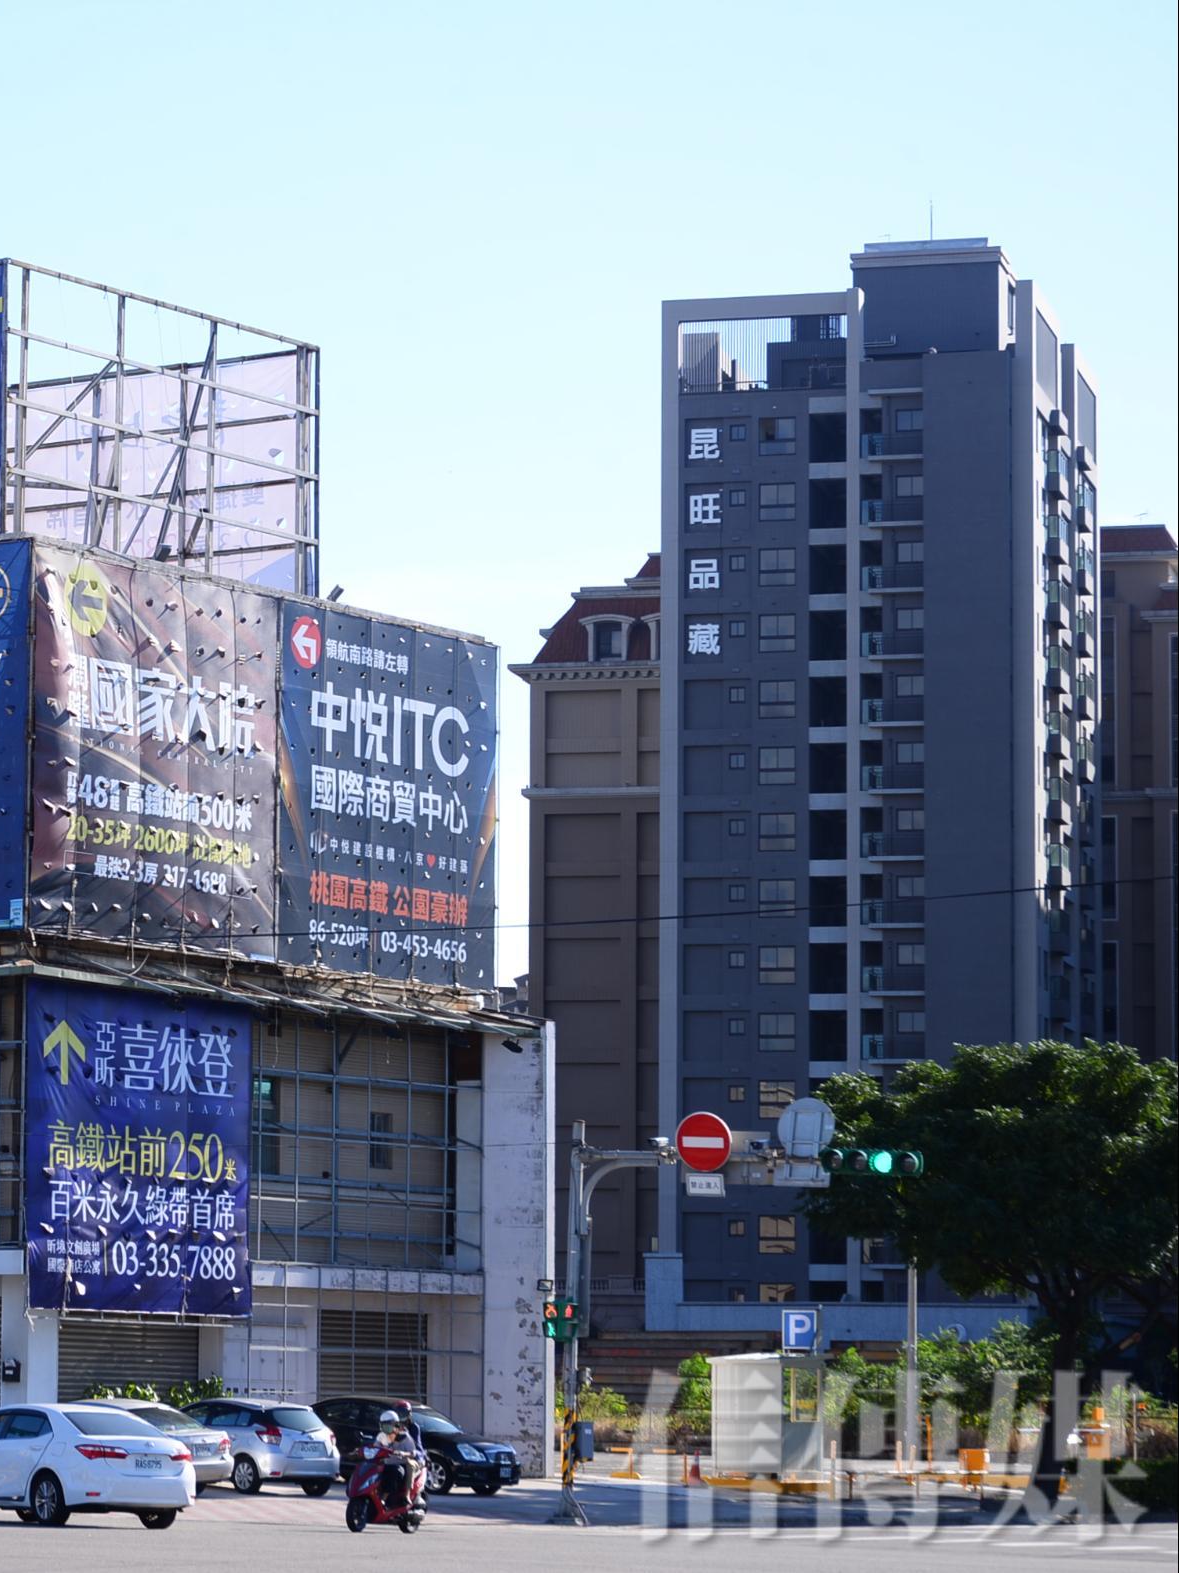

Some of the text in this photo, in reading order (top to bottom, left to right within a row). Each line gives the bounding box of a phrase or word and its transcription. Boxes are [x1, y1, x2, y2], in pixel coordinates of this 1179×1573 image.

[688, 428, 721, 655] 昆旺品藏
[325, 638, 409, 675] 領航南路請左轉
[310, 681, 469, 778] 中悅ITC
[310, 764, 468, 834] 國際商貿中心
[309, 870, 468, 927] 桃園高鐵 公園豪辦
[309, 919, 467, 963] 86-520坪 03-453-4656
[95, 1022, 116, 1088] 亞昕
[48, 1120, 236, 1182] 高鐵站前250米
[49, 1180, 236, 1231] 百米永久綠帶首席
[112, 1241, 236, 1280] 03-335-7888
[788, 1315, 810, 1343] P
